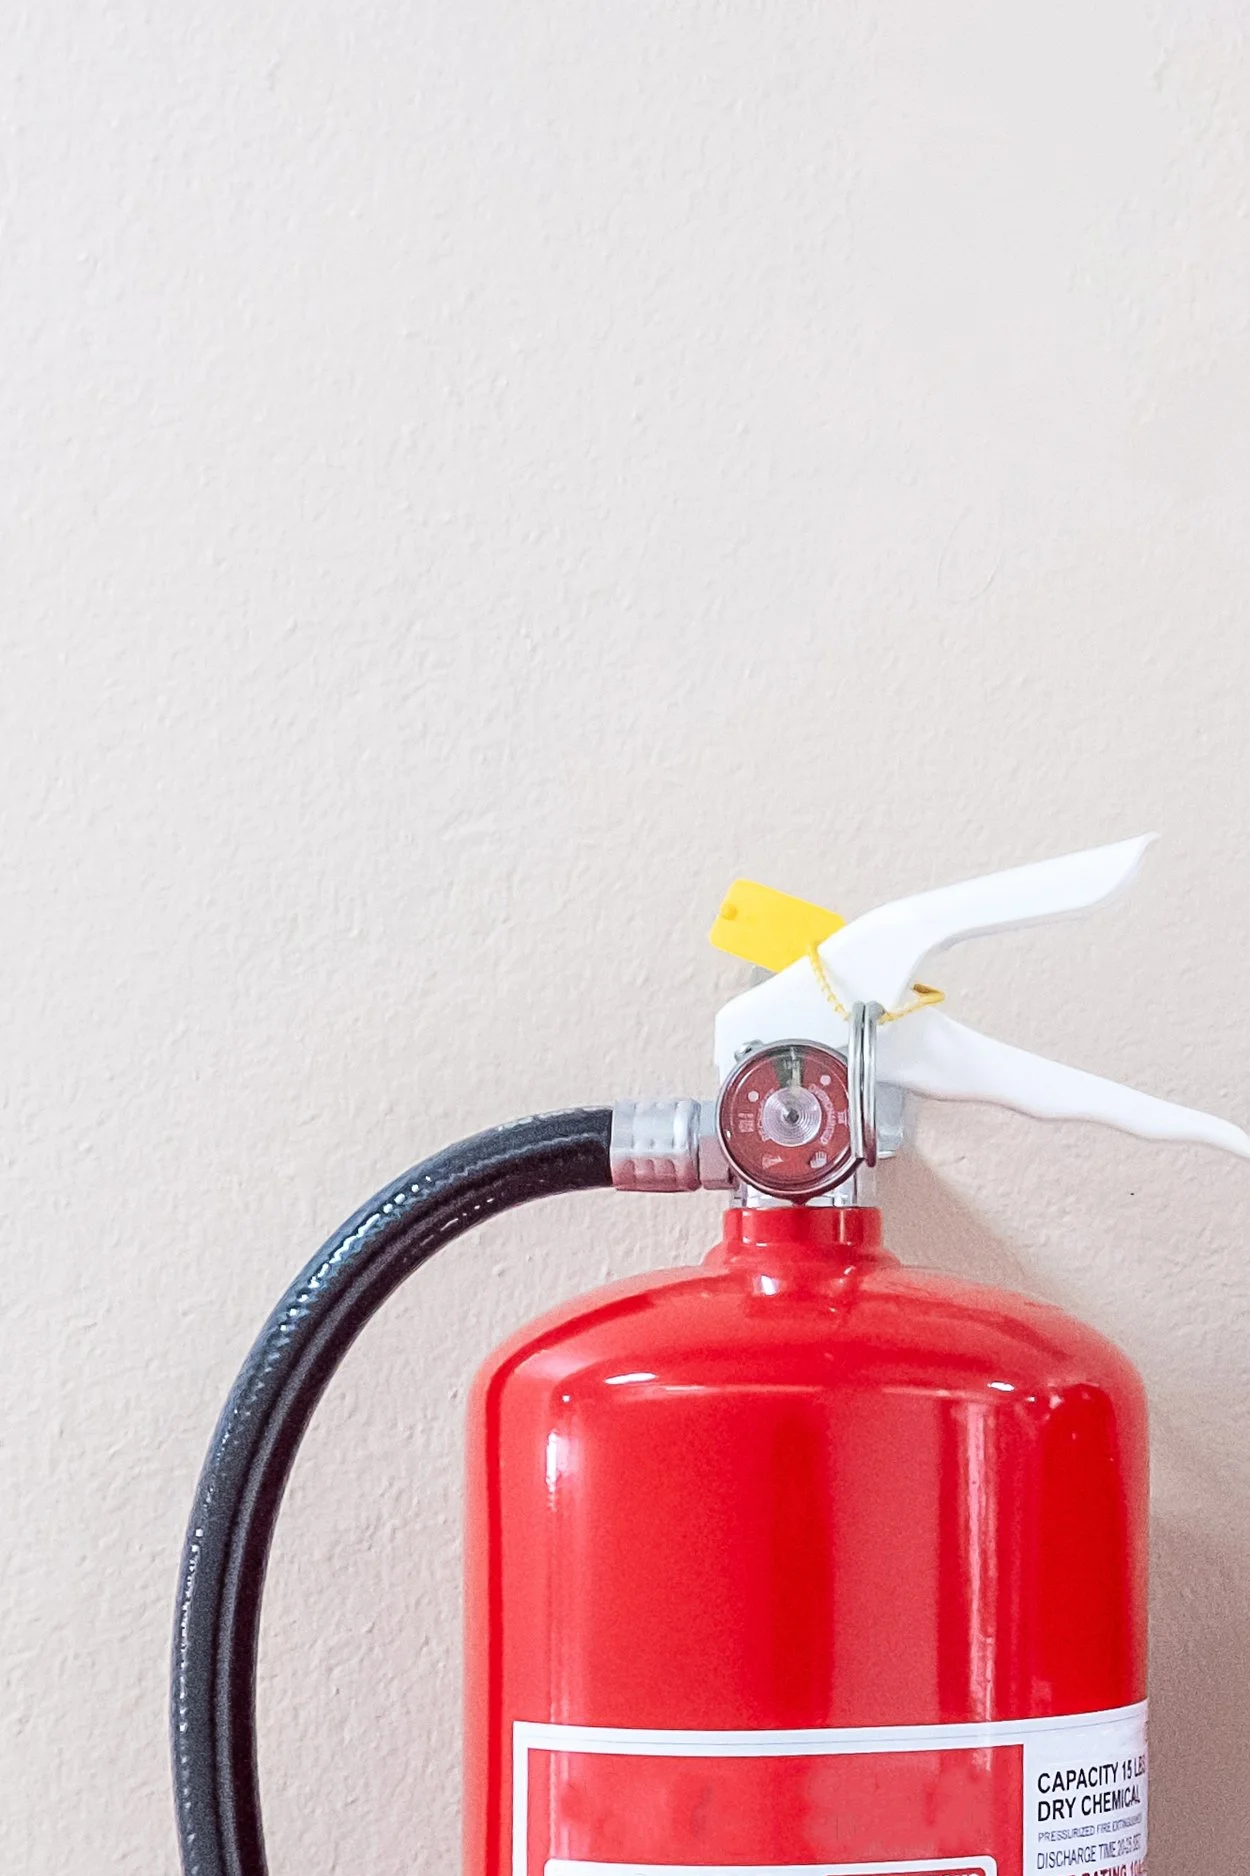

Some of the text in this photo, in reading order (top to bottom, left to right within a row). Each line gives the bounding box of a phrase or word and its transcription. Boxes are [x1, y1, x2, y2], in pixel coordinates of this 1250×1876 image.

[1037, 1762, 1119, 1794] CAPACITY
[1037, 1797, 1077, 1822] DRY
[1081, 1784, 1141, 1816] CHEMICAL
[1036, 1845, 1097, 1869] DISCHARGE
